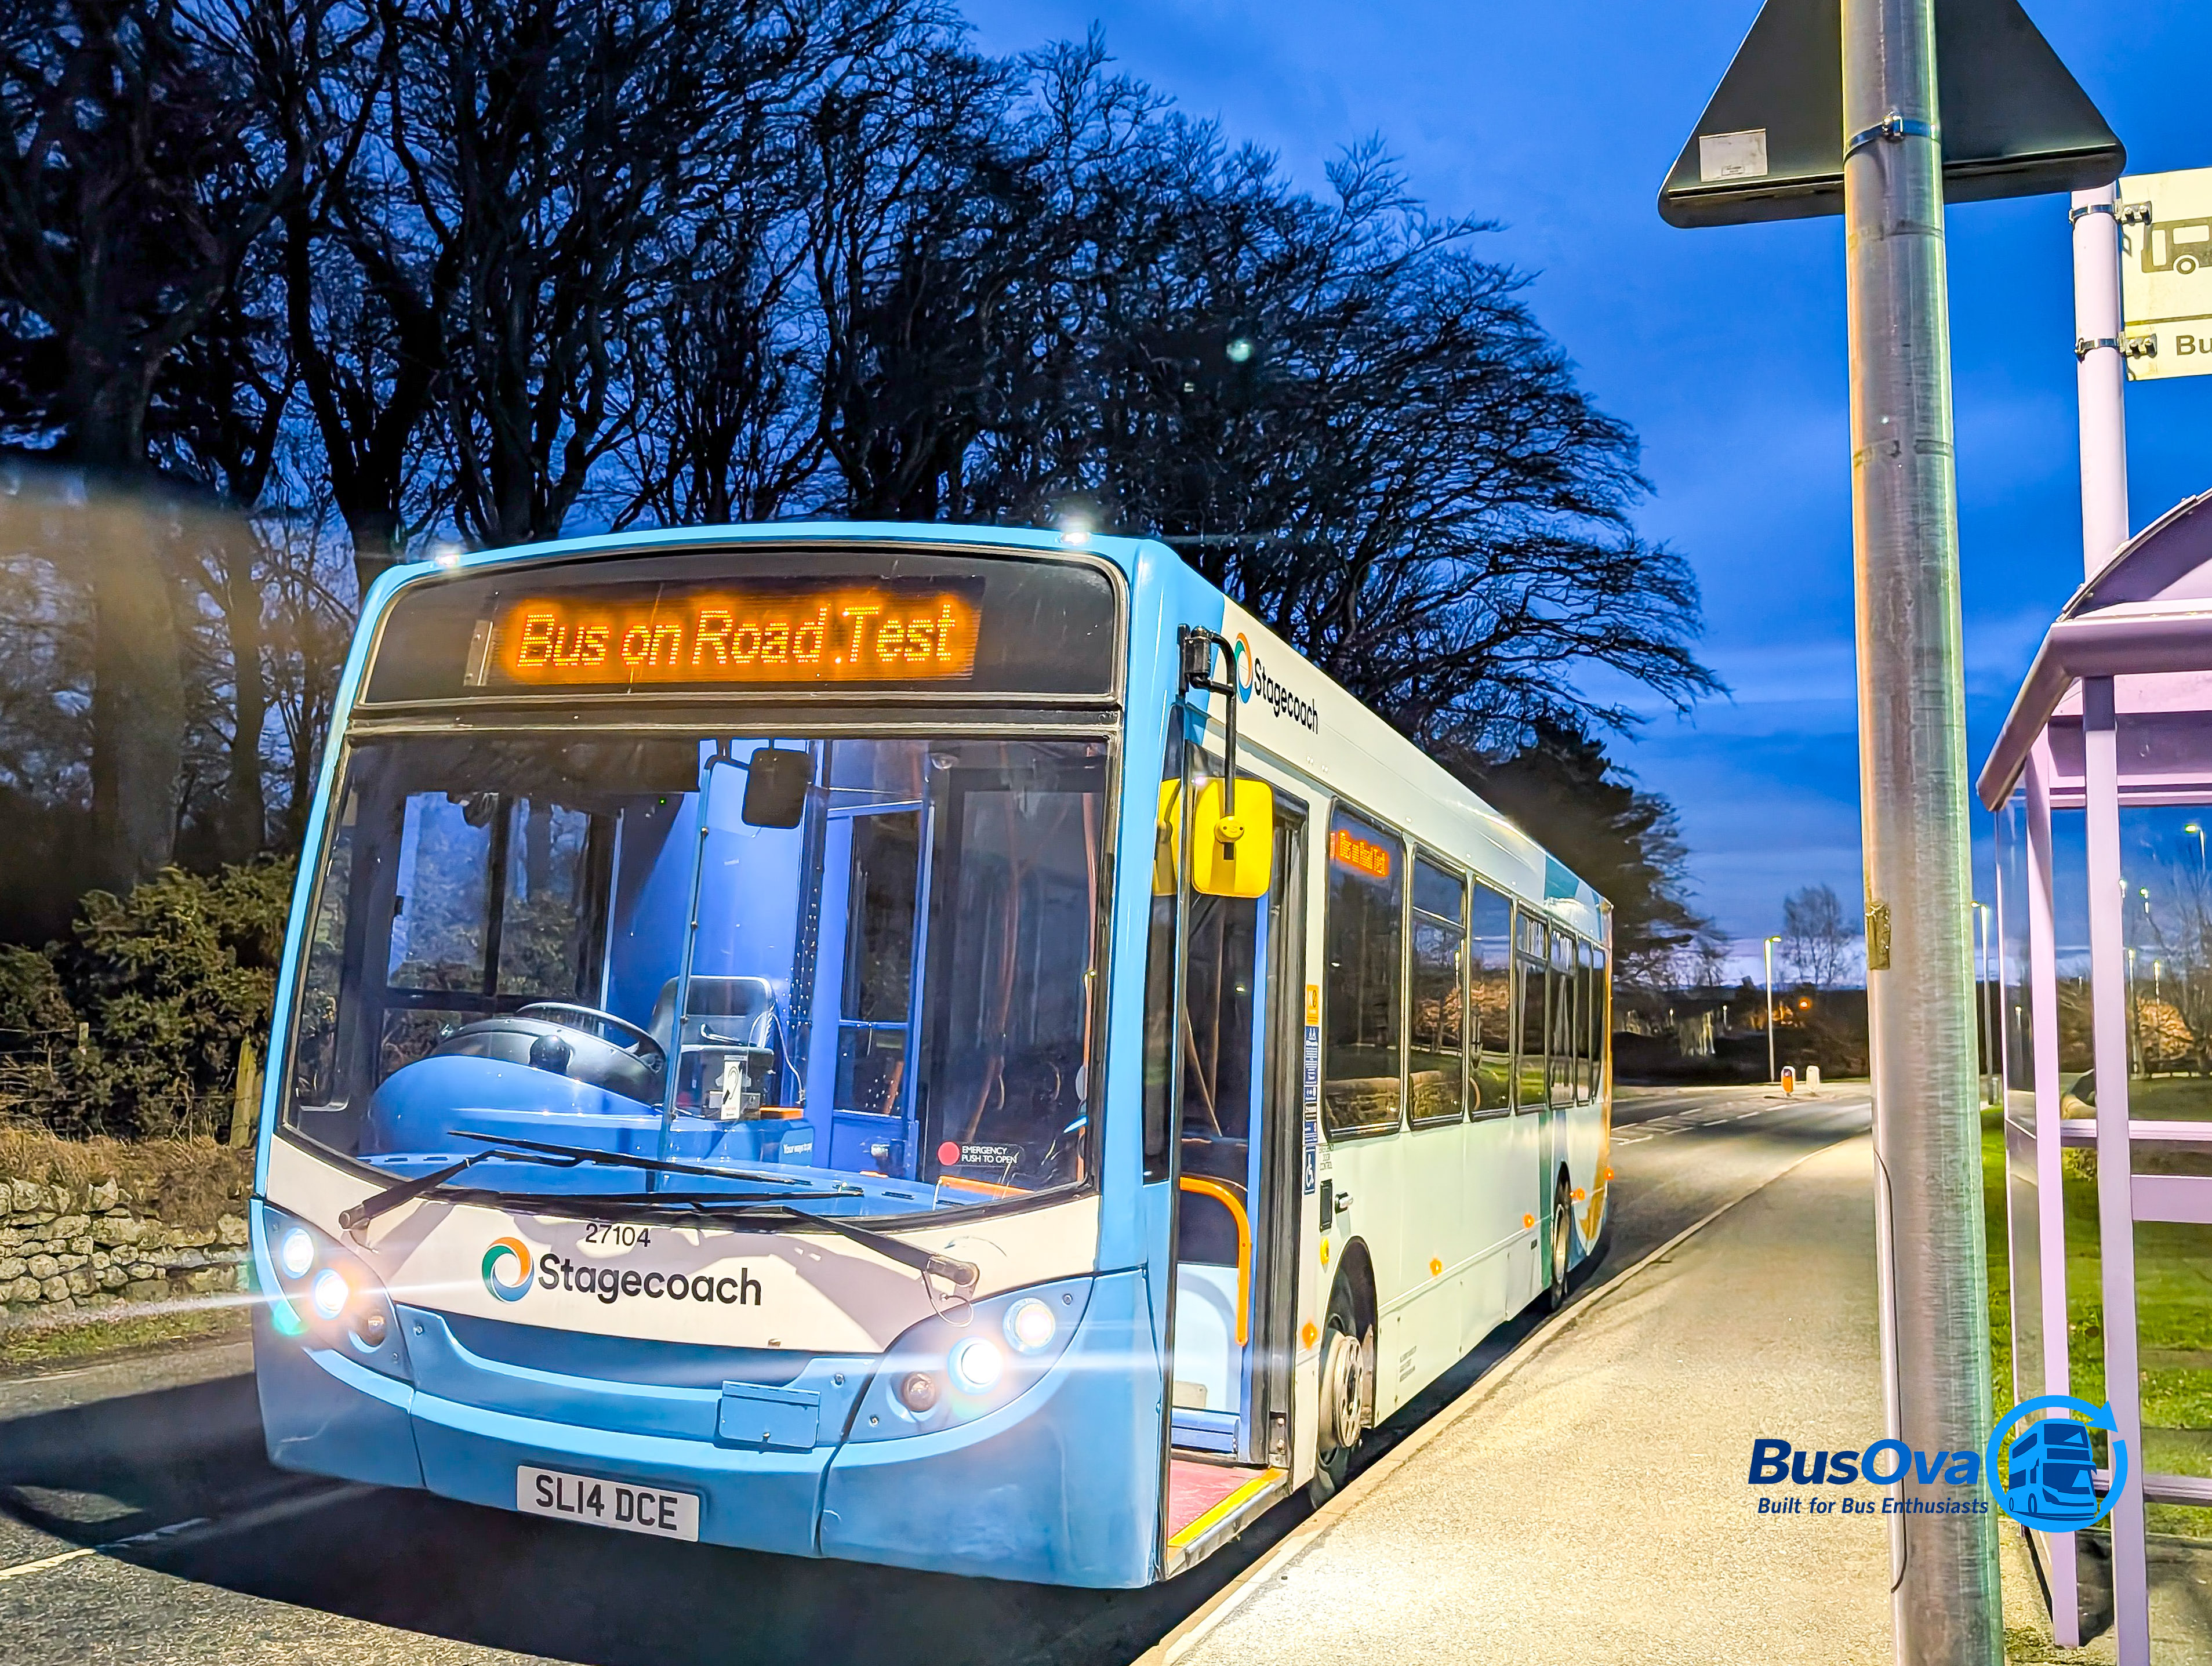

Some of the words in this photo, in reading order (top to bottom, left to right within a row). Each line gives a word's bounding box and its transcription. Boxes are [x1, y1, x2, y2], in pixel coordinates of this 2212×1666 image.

[517, 612, 609, 667] Bus
[621, 623, 683, 666] on
[692, 603, 830, 665] Road
[844, 603, 956, 664] Test
[1254, 658, 1318, 735] Stagecoach
[961, 1155, 981, 1163] PUSH
[983, 1155, 994, 1163] TO
[996, 1156, 1017, 1164] OPEN
[962, 1146, 1007, 1155] EMERGENCY
[585, 1223, 651, 1247] 27104
[538, 1253, 761, 1306] Stagecoach
[536, 1475, 604, 1517] SL14
[616, 1487, 677, 1530] DCE
